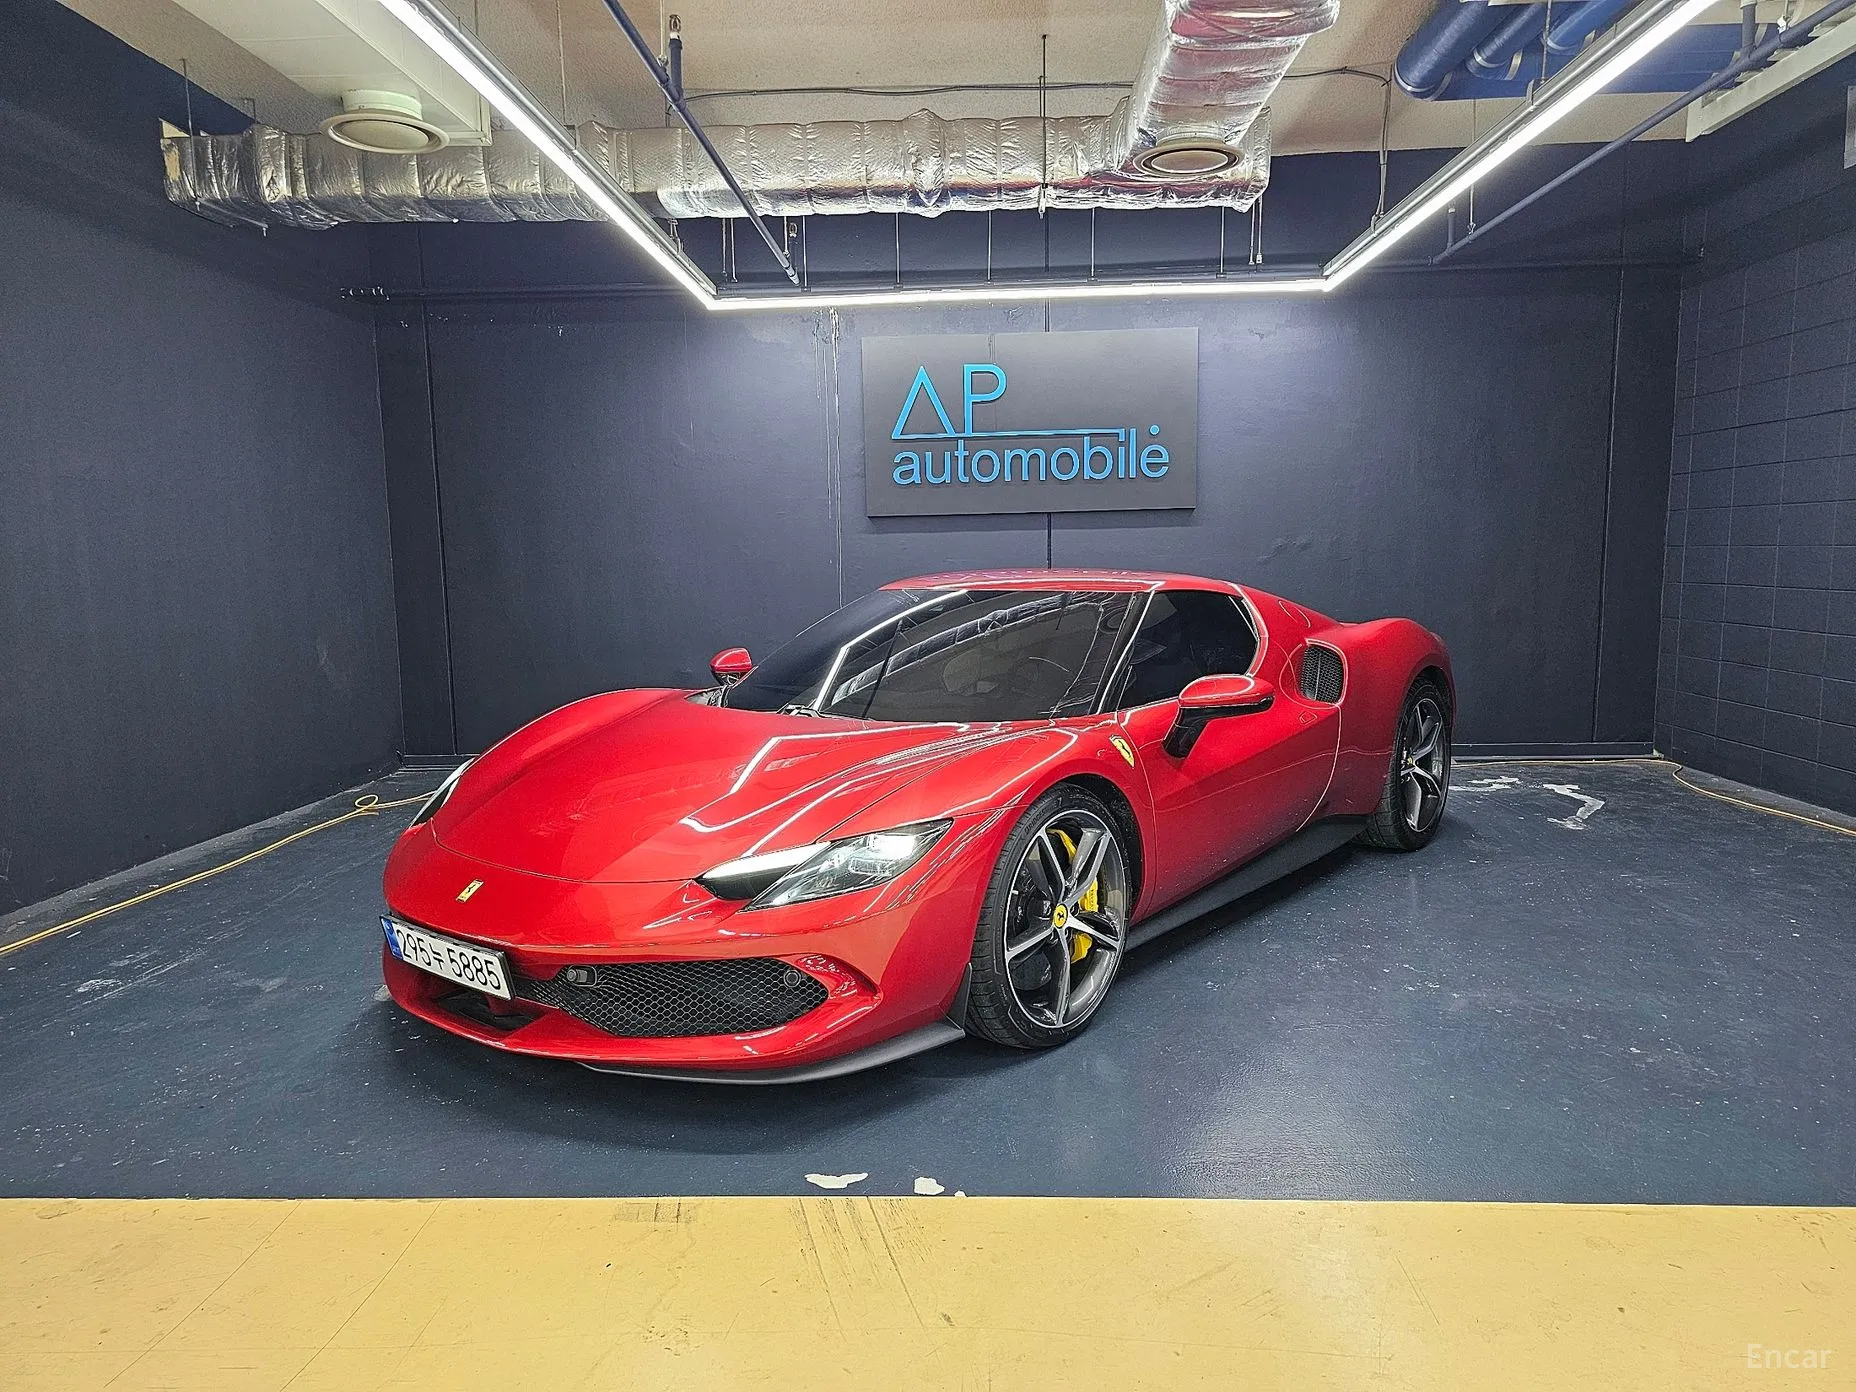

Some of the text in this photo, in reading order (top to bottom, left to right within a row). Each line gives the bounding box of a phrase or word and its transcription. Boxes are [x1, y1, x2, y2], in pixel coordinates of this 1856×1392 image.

[892, 363, 1008, 439] AP
[892, 427, 1170, 484] automobile
[446, 948, 501, 990] 5885
